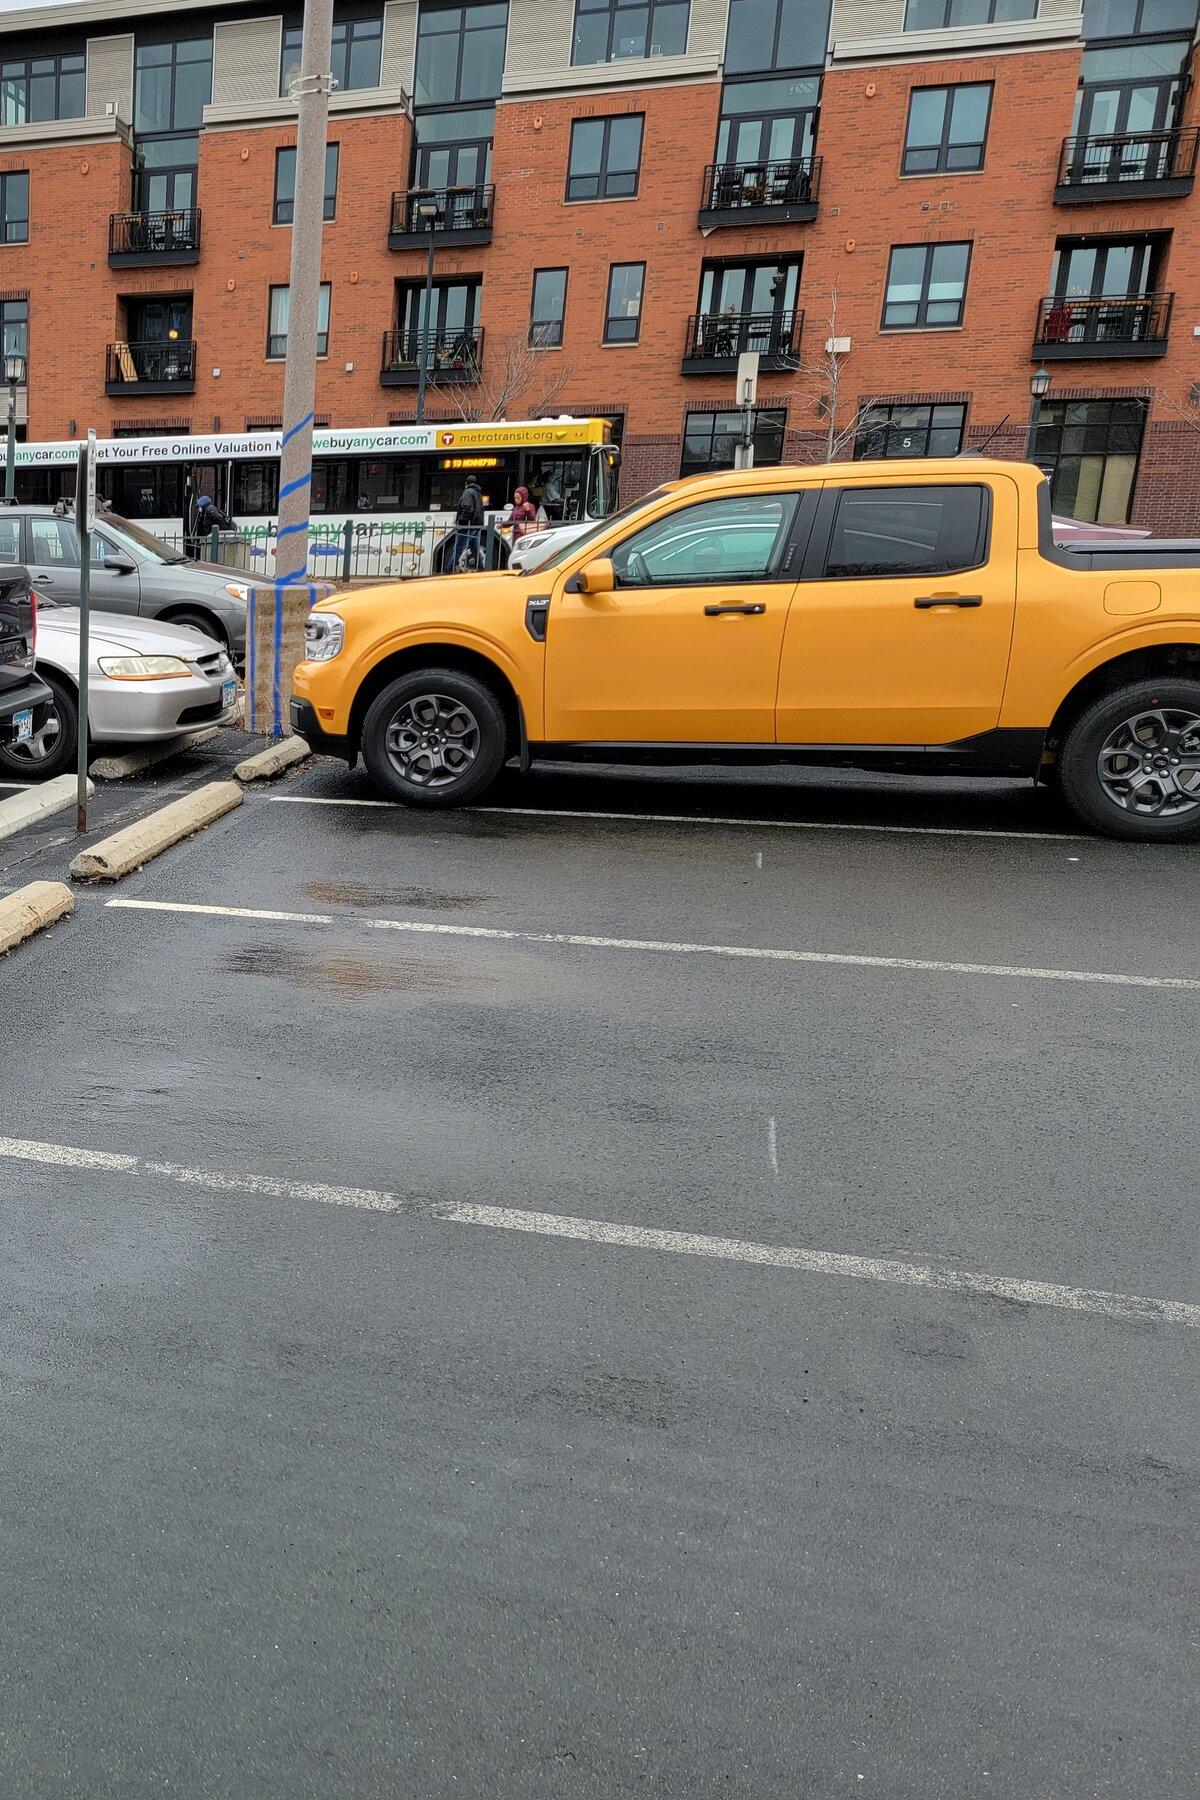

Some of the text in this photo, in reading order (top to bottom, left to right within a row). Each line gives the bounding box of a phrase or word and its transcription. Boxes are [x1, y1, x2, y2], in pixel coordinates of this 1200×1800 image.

[313, 434, 428, 450] webuyanycar.com
[460, 431, 553, 442] metrotransit.org
[902, 437, 912, 448] 5
[112, 447, 138, 458] Your
[142, 445, 168, 456] Free
[172, 443, 211, 455] Online
[214, 441, 272, 453] Valuation
